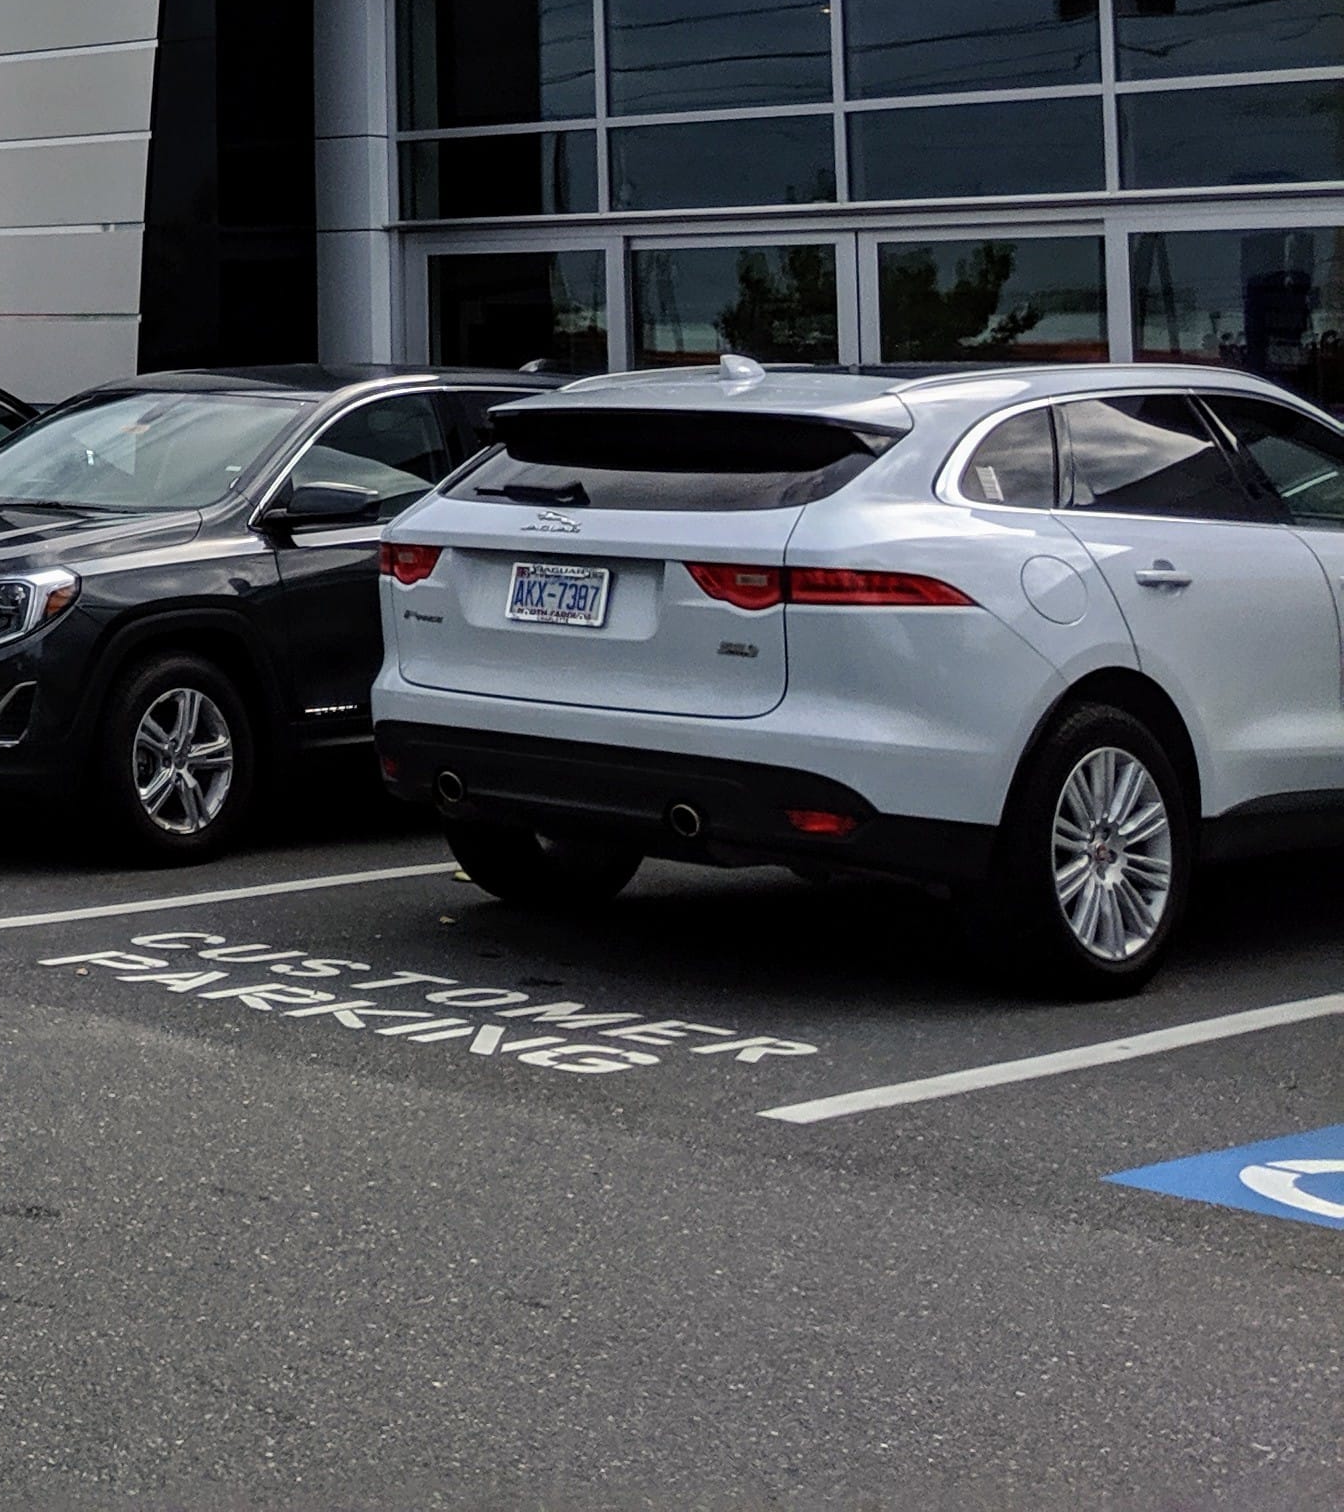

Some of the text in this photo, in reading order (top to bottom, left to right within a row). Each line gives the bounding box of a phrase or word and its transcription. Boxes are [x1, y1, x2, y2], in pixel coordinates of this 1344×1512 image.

[514, 579, 601, 612] AKX-7387
[37, 950, 662, 1075] PARKING
[130, 931, 819, 1064] CUSTOMER
